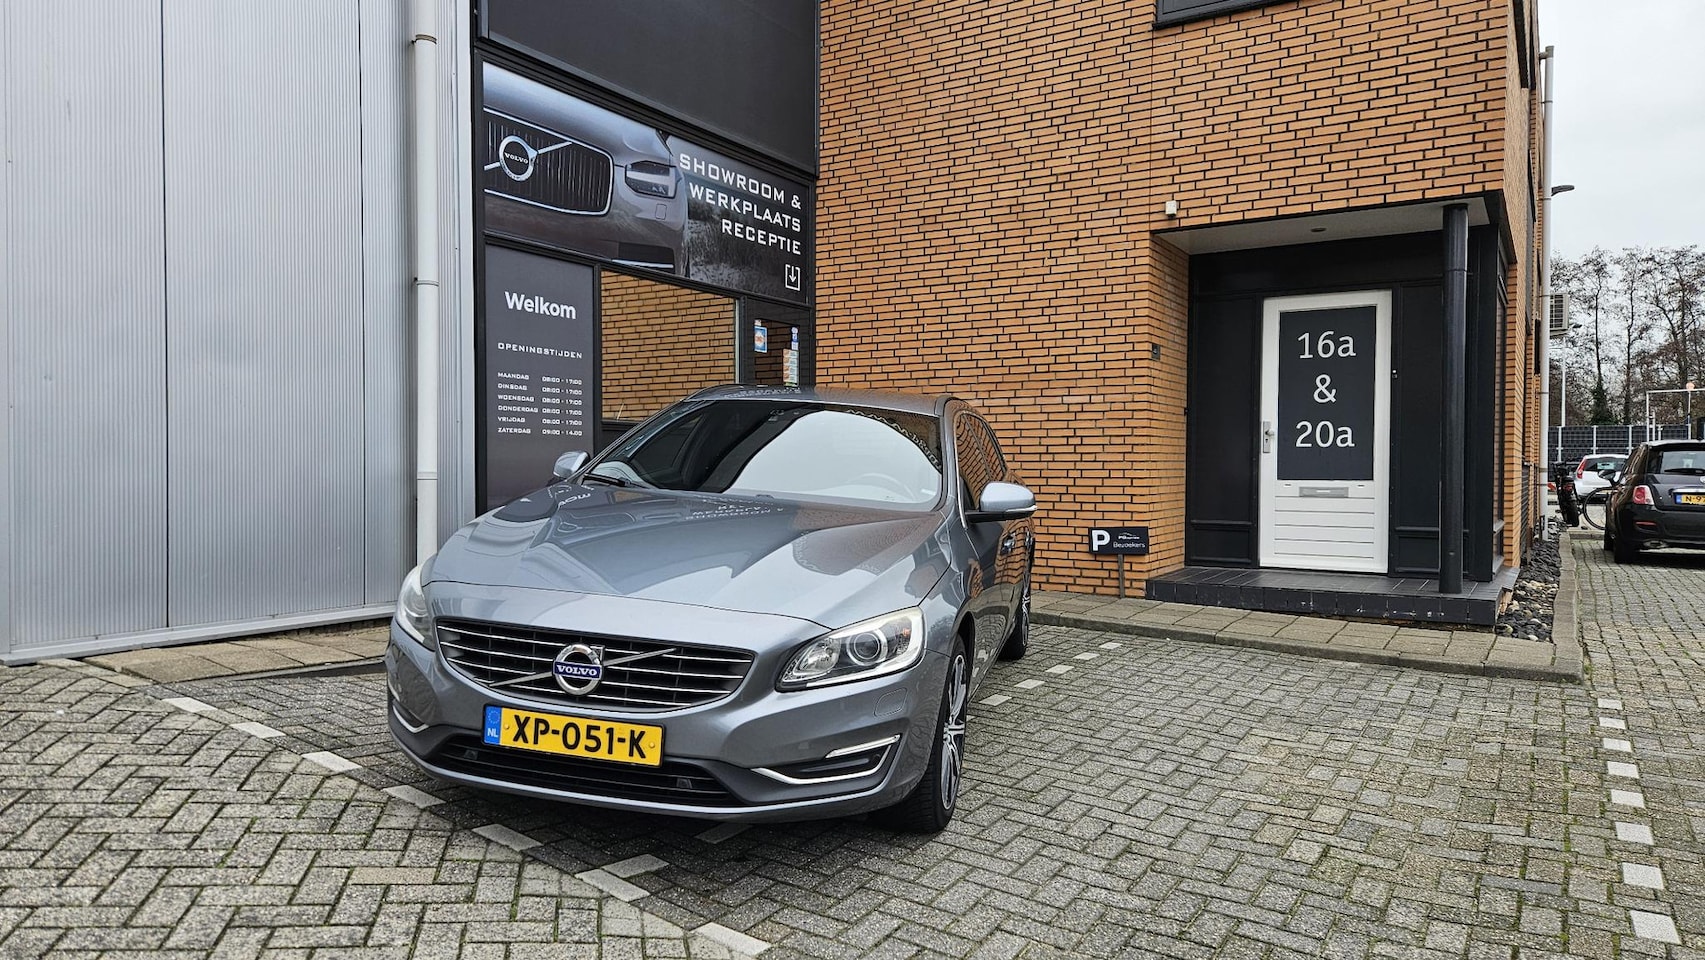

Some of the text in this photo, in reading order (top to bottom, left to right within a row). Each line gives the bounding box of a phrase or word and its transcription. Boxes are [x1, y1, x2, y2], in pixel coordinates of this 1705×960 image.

[504, 152, 528, 164] VOLVO
[679, 153, 801, 210] SHOWROOM &
[689, 182, 801, 232] WERKPLAATS
[722, 218, 801, 255] RECEPTIE
[504, 291, 577, 319] Welkom
[497, 342, 582, 359] OPENINGSTIJDEN
[1297, 330, 1357, 359] 16a
[497, 372, 530, 380] MAANDAG
[497, 383, 528, 391] DINSDAG
[1313, 373, 1337, 404] &
[497, 394, 535, 402] WOENSDAG
[497, 405, 539, 413] DONDERDAG
[1295, 420, 1355, 448] 20a
[1091, 529, 1111, 551] P
[556, 664, 598, 676] VOLVO
[487, 714, 647, 759] NL XP-051-K
